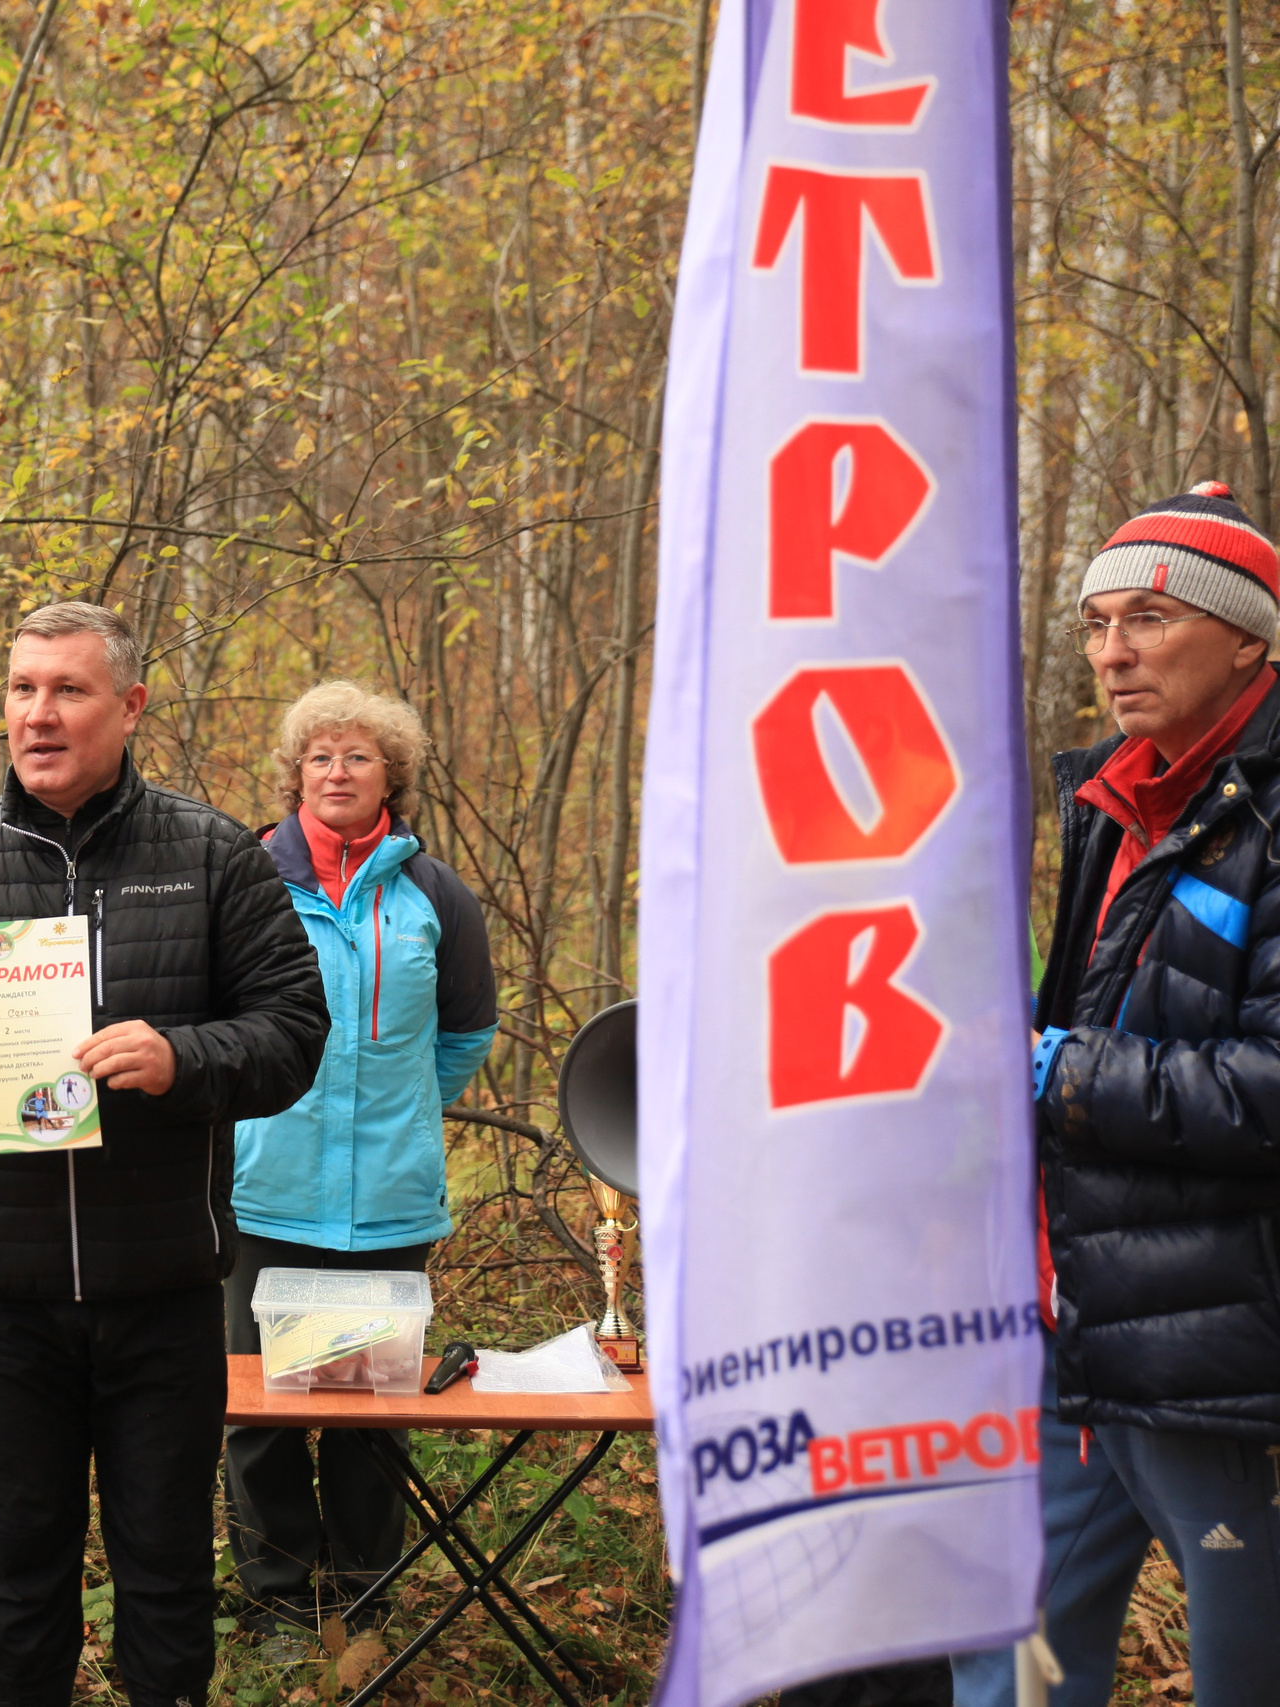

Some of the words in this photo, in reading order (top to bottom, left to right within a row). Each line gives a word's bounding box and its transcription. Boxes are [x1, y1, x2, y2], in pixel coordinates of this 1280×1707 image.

[121, 882, 195, 896] FINNTRAIL
[7, 1006, 40, 1018] Сергей
[5, 1027, 10, 1035] 2
[692, 1408, 816, 1497] РОЗА
[1200, 1538, 1245, 1549] adidas
